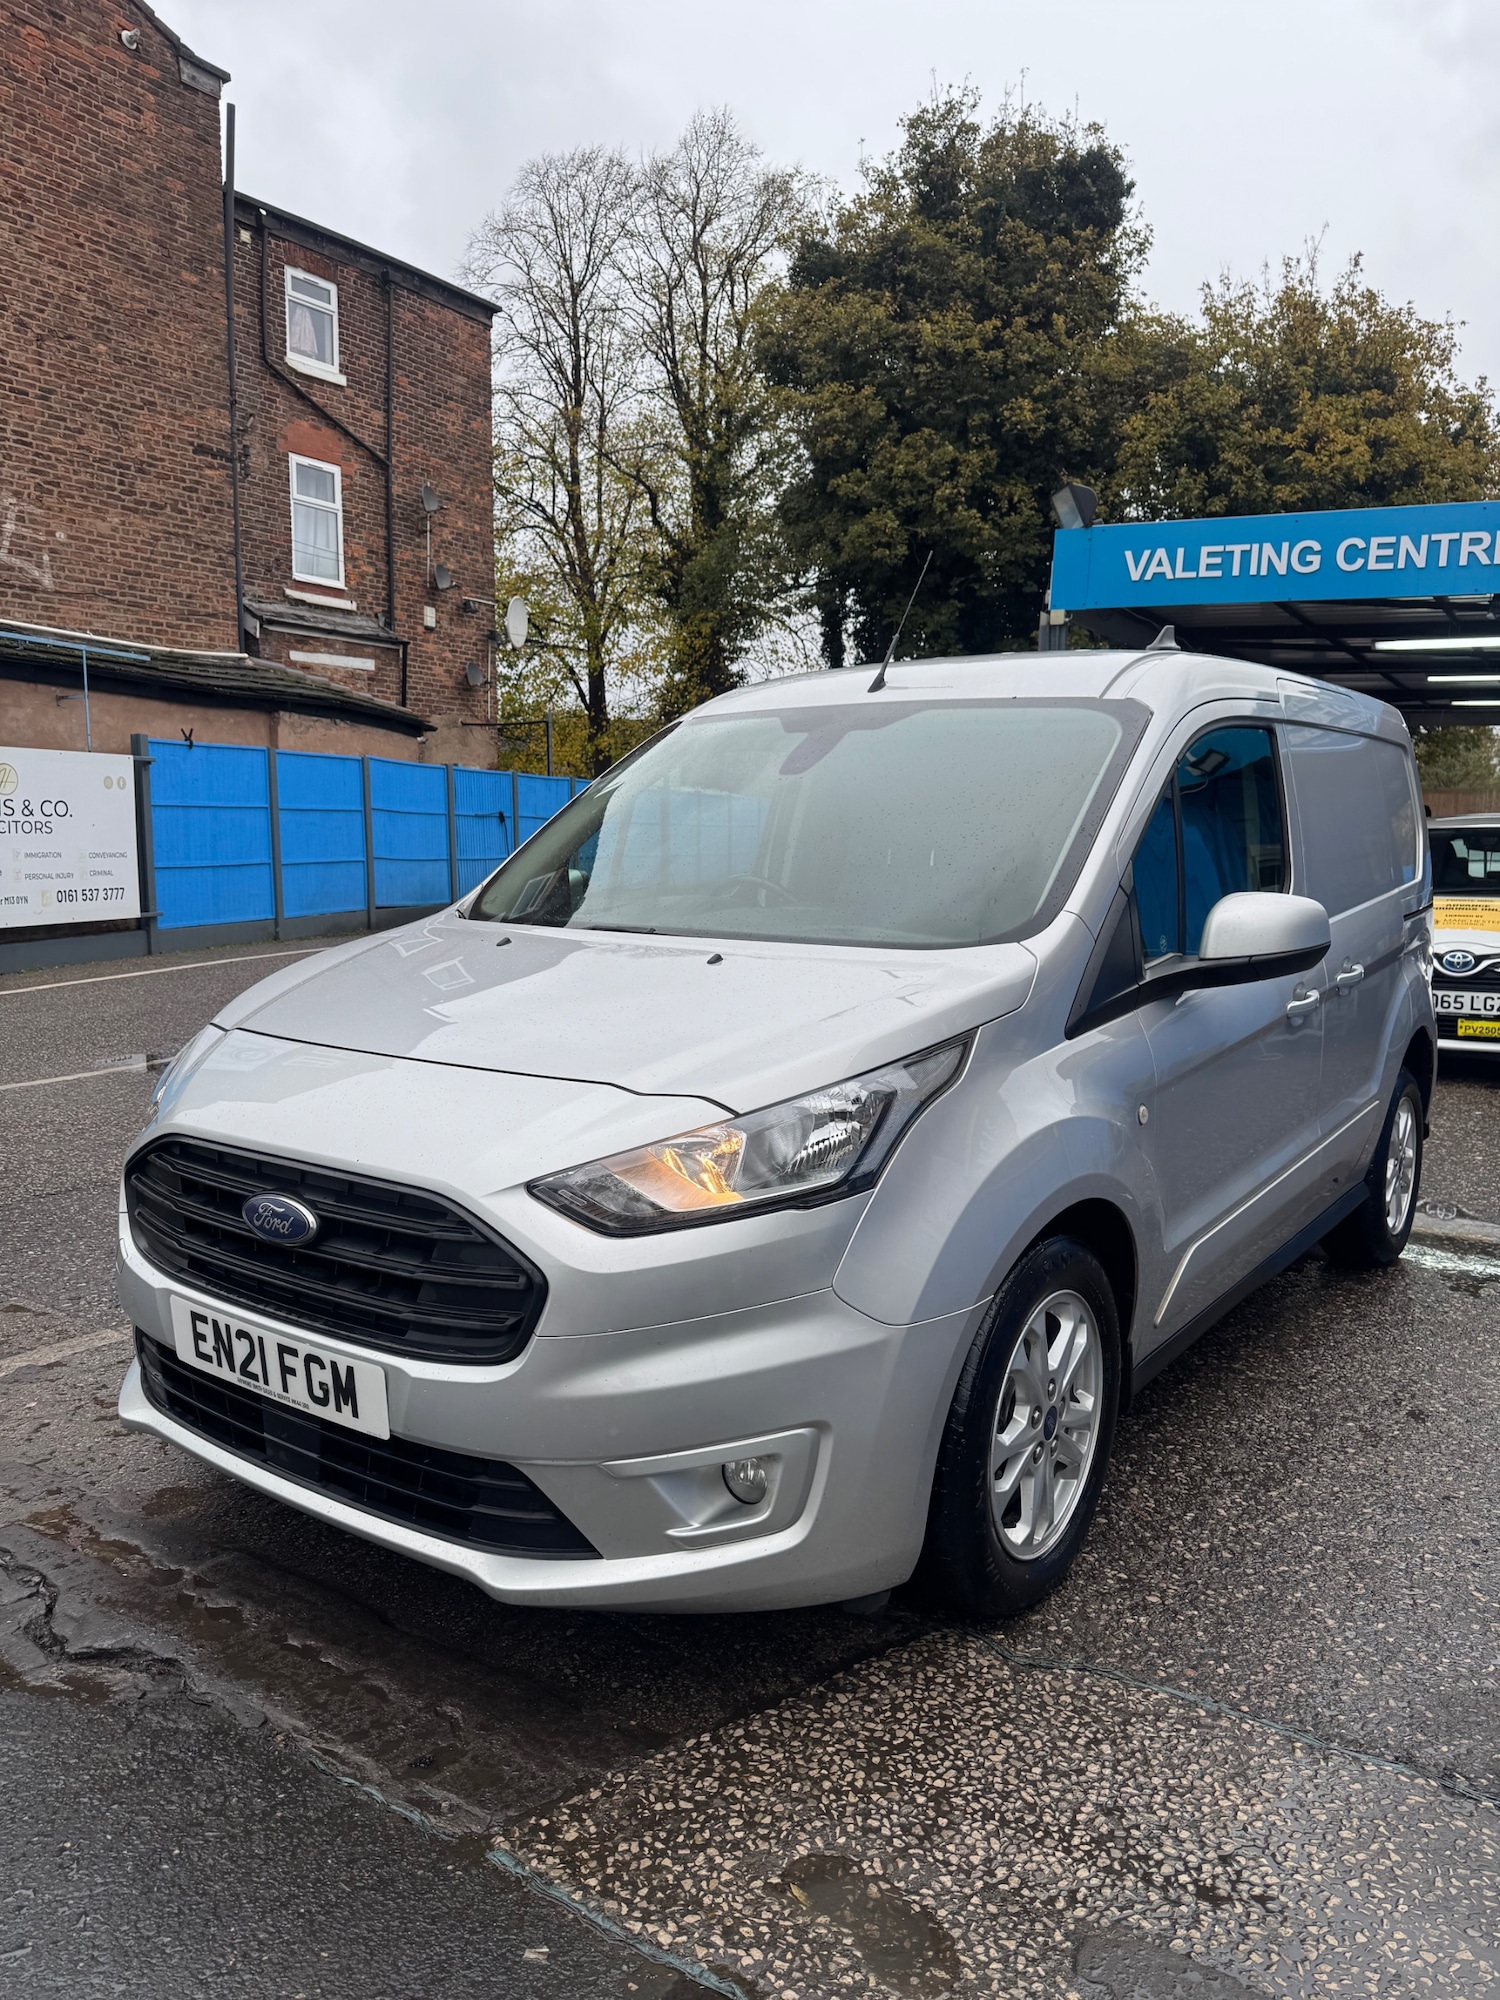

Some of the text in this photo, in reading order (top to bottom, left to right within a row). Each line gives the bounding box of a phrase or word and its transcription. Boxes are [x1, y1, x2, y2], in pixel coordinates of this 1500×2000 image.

[1124, 530, 1500, 582] VALETING CENTR
[0, 798, 73, 818] S & CO.
[24, 851, 62, 859] IMMIGRATION
[88, 851, 128, 859] CONVEYANCING
[24, 872, 74, 880] PERSONAL INJURY
[89, 869, 114, 877] CRIMINAL
[56, 887, 125, 903] 0161 537 3777
[253, 1202, 295, 1235] Ford
[190, 1310, 359, 1420] EN21 FGM
